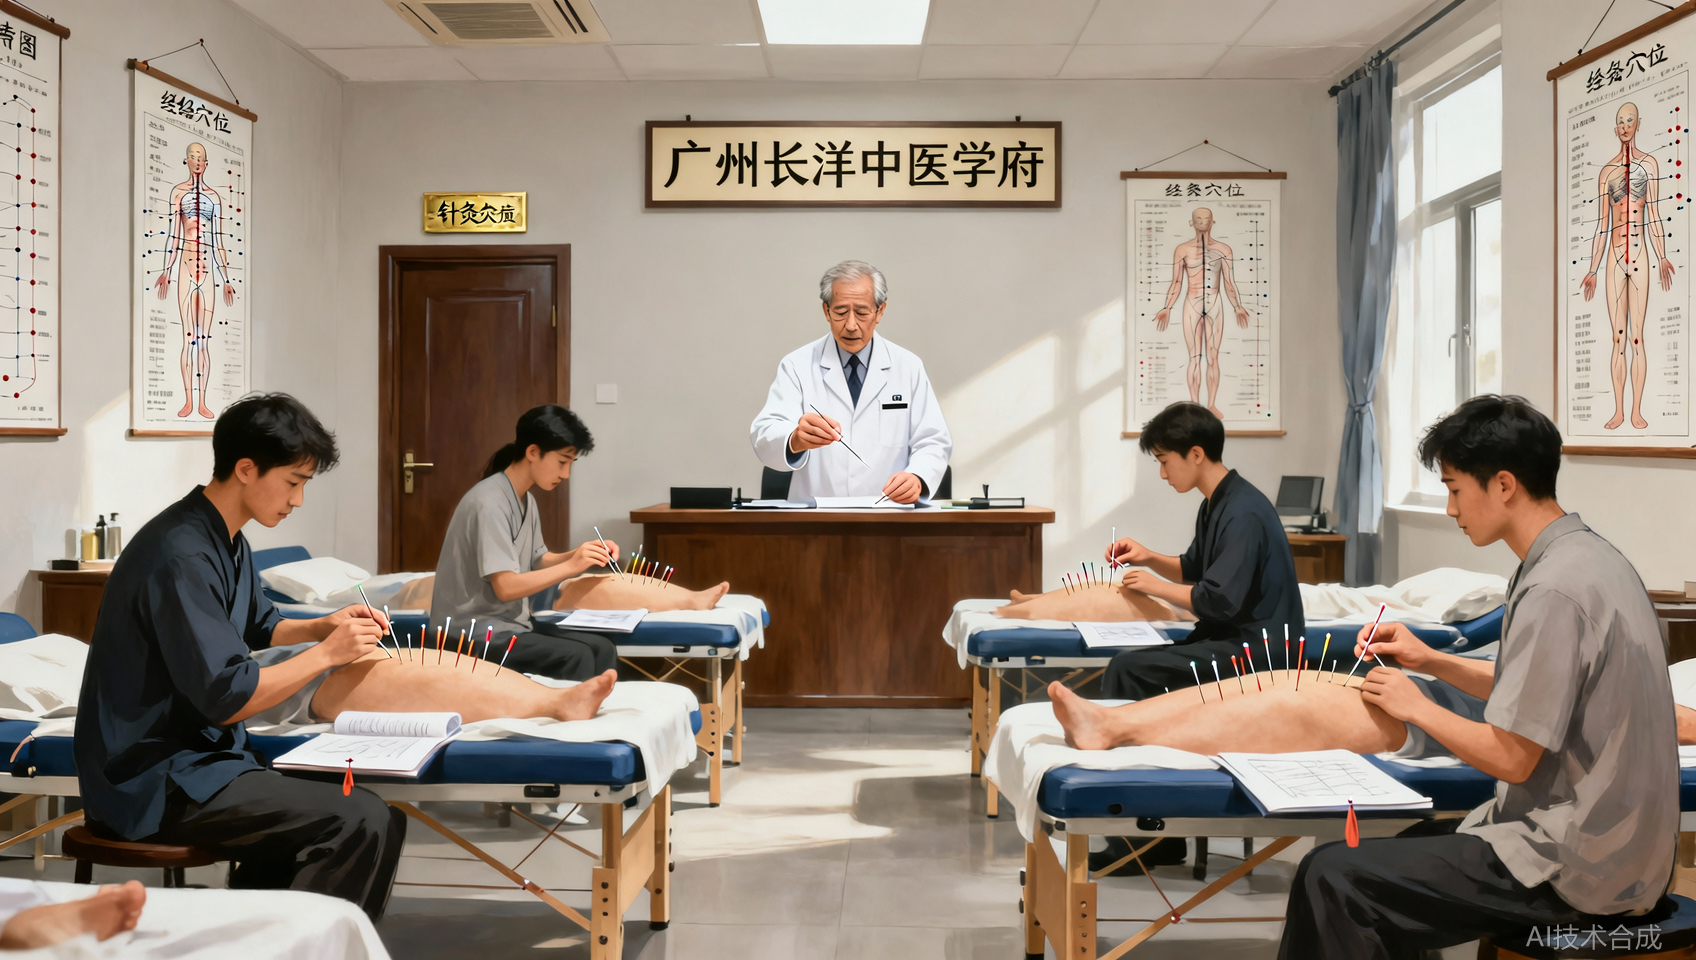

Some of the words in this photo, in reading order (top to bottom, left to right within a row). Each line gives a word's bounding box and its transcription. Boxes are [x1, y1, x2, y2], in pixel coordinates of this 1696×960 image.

[664, 139, 1044, 188] 广州长洋中医学府
